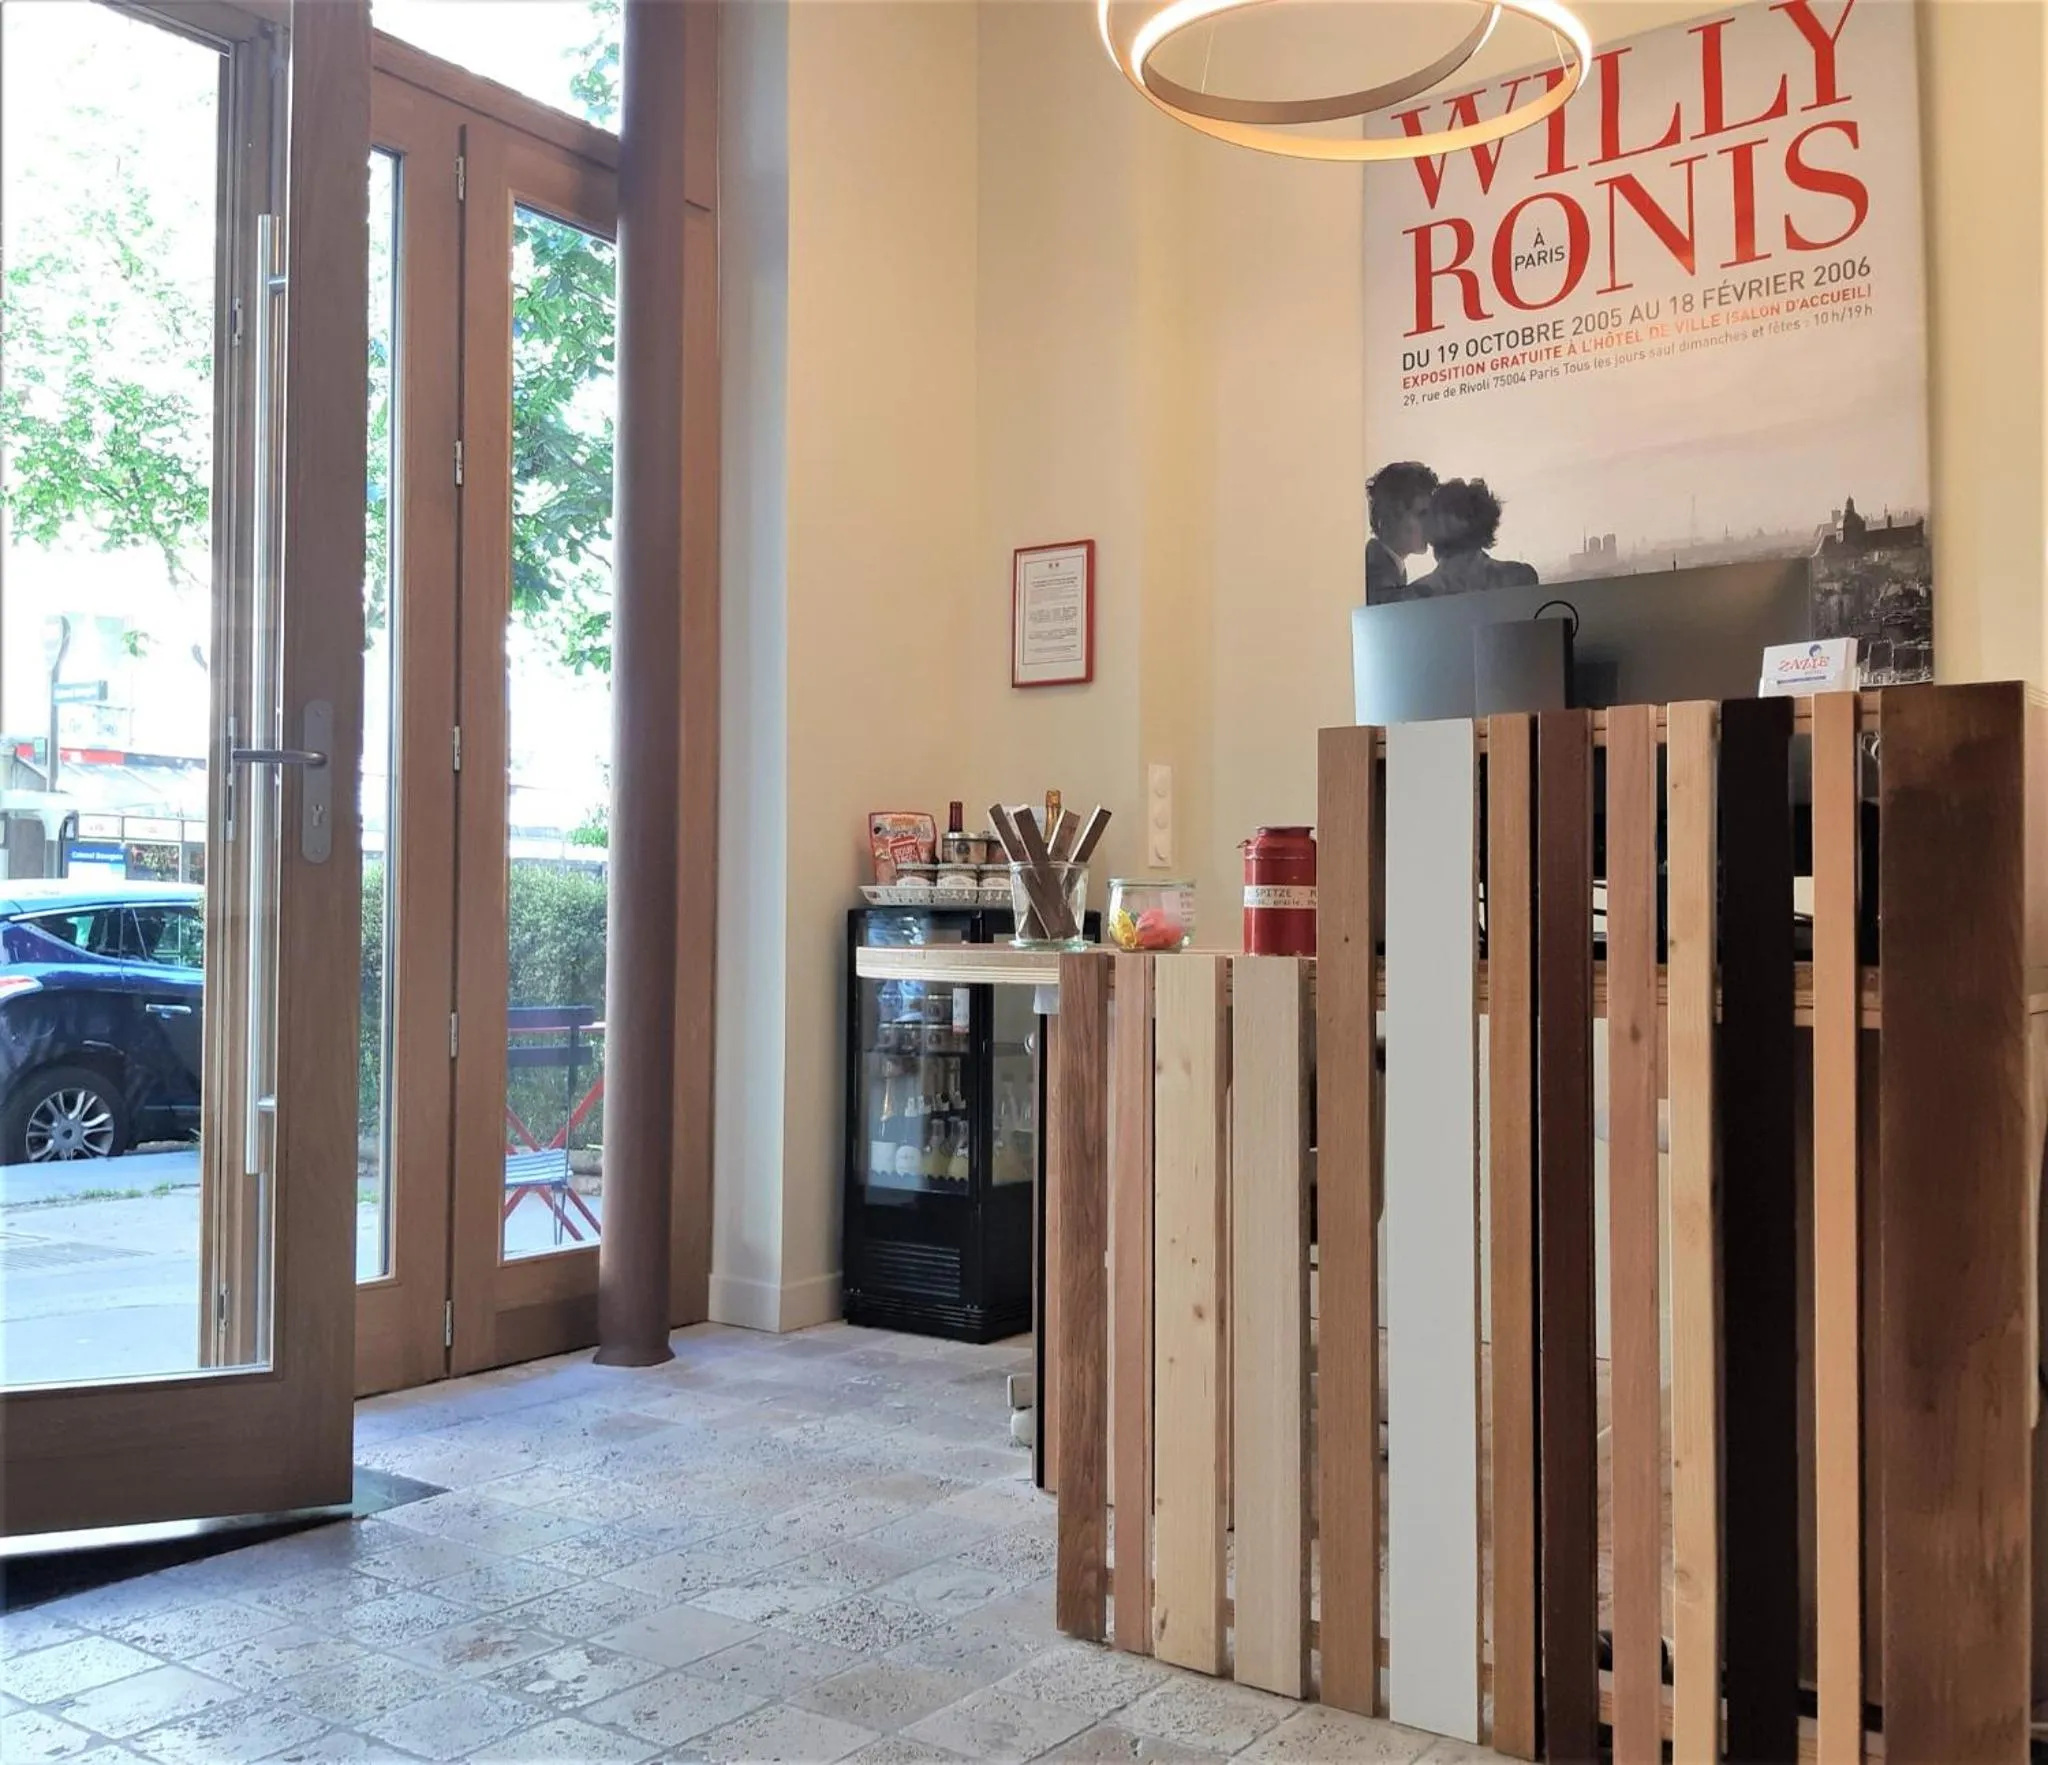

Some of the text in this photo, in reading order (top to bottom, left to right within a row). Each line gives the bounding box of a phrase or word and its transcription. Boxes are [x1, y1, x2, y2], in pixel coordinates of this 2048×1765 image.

[1391, 0, 1855, 209] WILLY
[1403, 120, 1869, 337] RONIS
[1514, 245, 1565, 271] PARIS
[1533, 226, 1545, 248] À
[1402, 256, 1872, 371] DU 19 OCTOBRE 2005 AU 18 FÉVRIER 2006
[1402, 283, 1873, 390] EXPOSITION GRATUITE À L'HÔTEL DE VILLE (SALON D'ACCUEIL)
[1422, 390, 1440, 402] rue
[1443, 386, 1457, 398] de
[1459, 377, 1491, 395] Rivoli
[1493, 372, 1527, 388] 75004
[1529, 364, 1560, 380] Paris
[1563, 360, 1591, 375] Tous
[1593, 356, 1612, 369] les
[1613, 350, 1647, 369] jours
[1679, 329, 1748, 353] dimanches
[1751, 324, 1764, 338] et
[1767, 317, 1801, 335] fêtes
